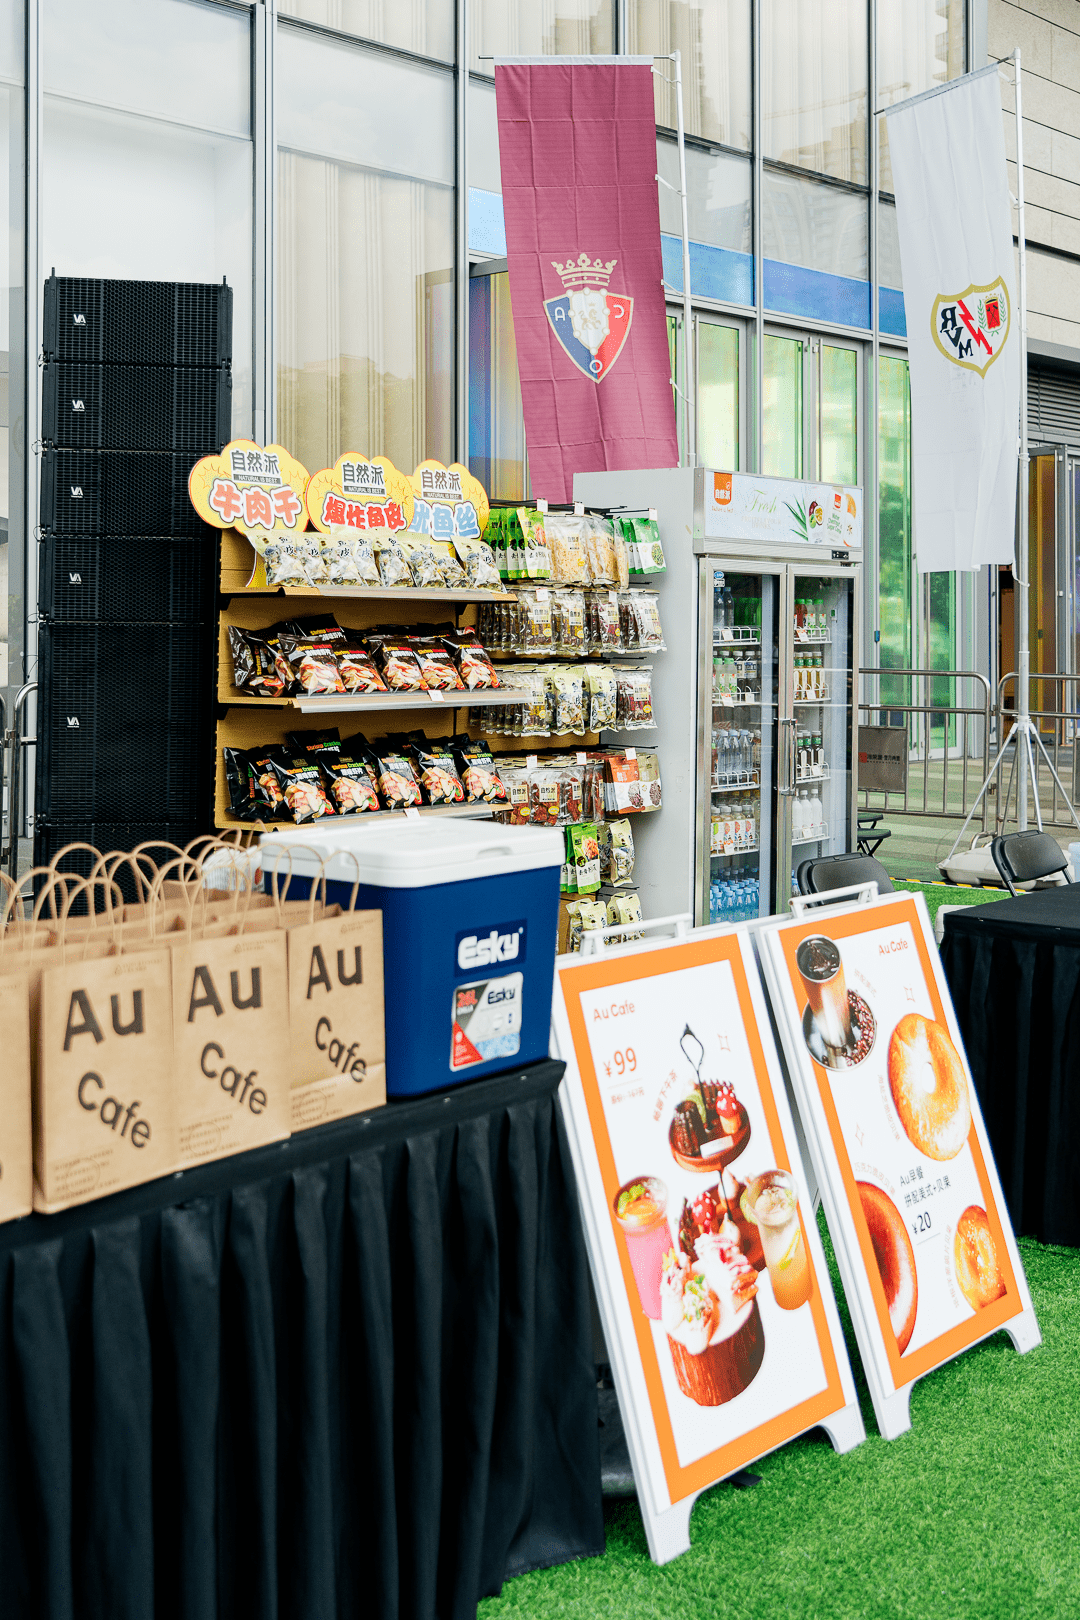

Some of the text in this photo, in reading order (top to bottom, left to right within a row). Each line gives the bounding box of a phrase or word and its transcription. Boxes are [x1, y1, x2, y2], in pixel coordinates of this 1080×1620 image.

[231, 450, 280, 474] 自然派
[343, 463, 384, 486] 自然派
[422, 470, 461, 491] 自然派
[212, 483, 299, 526] 牛肉干
[324, 496, 405, 530] 爆炸鱼皮
[458, 930, 520, 970] Esky
[879, 938, 909, 956] Au Cafe
[306, 944, 364, 1000] Au
[187, 965, 263, 1023] Au
[487, 988, 515, 1005] Esky
[593, 1000, 636, 1022] Au Cafe
[63, 988, 145, 1052] Au
[315, 1016, 367, 1083] Cafe
[603, 1047, 638, 1077] ¥99
[200, 1042, 268, 1115] Cafe
[78, 1072, 152, 1148] Cafe
